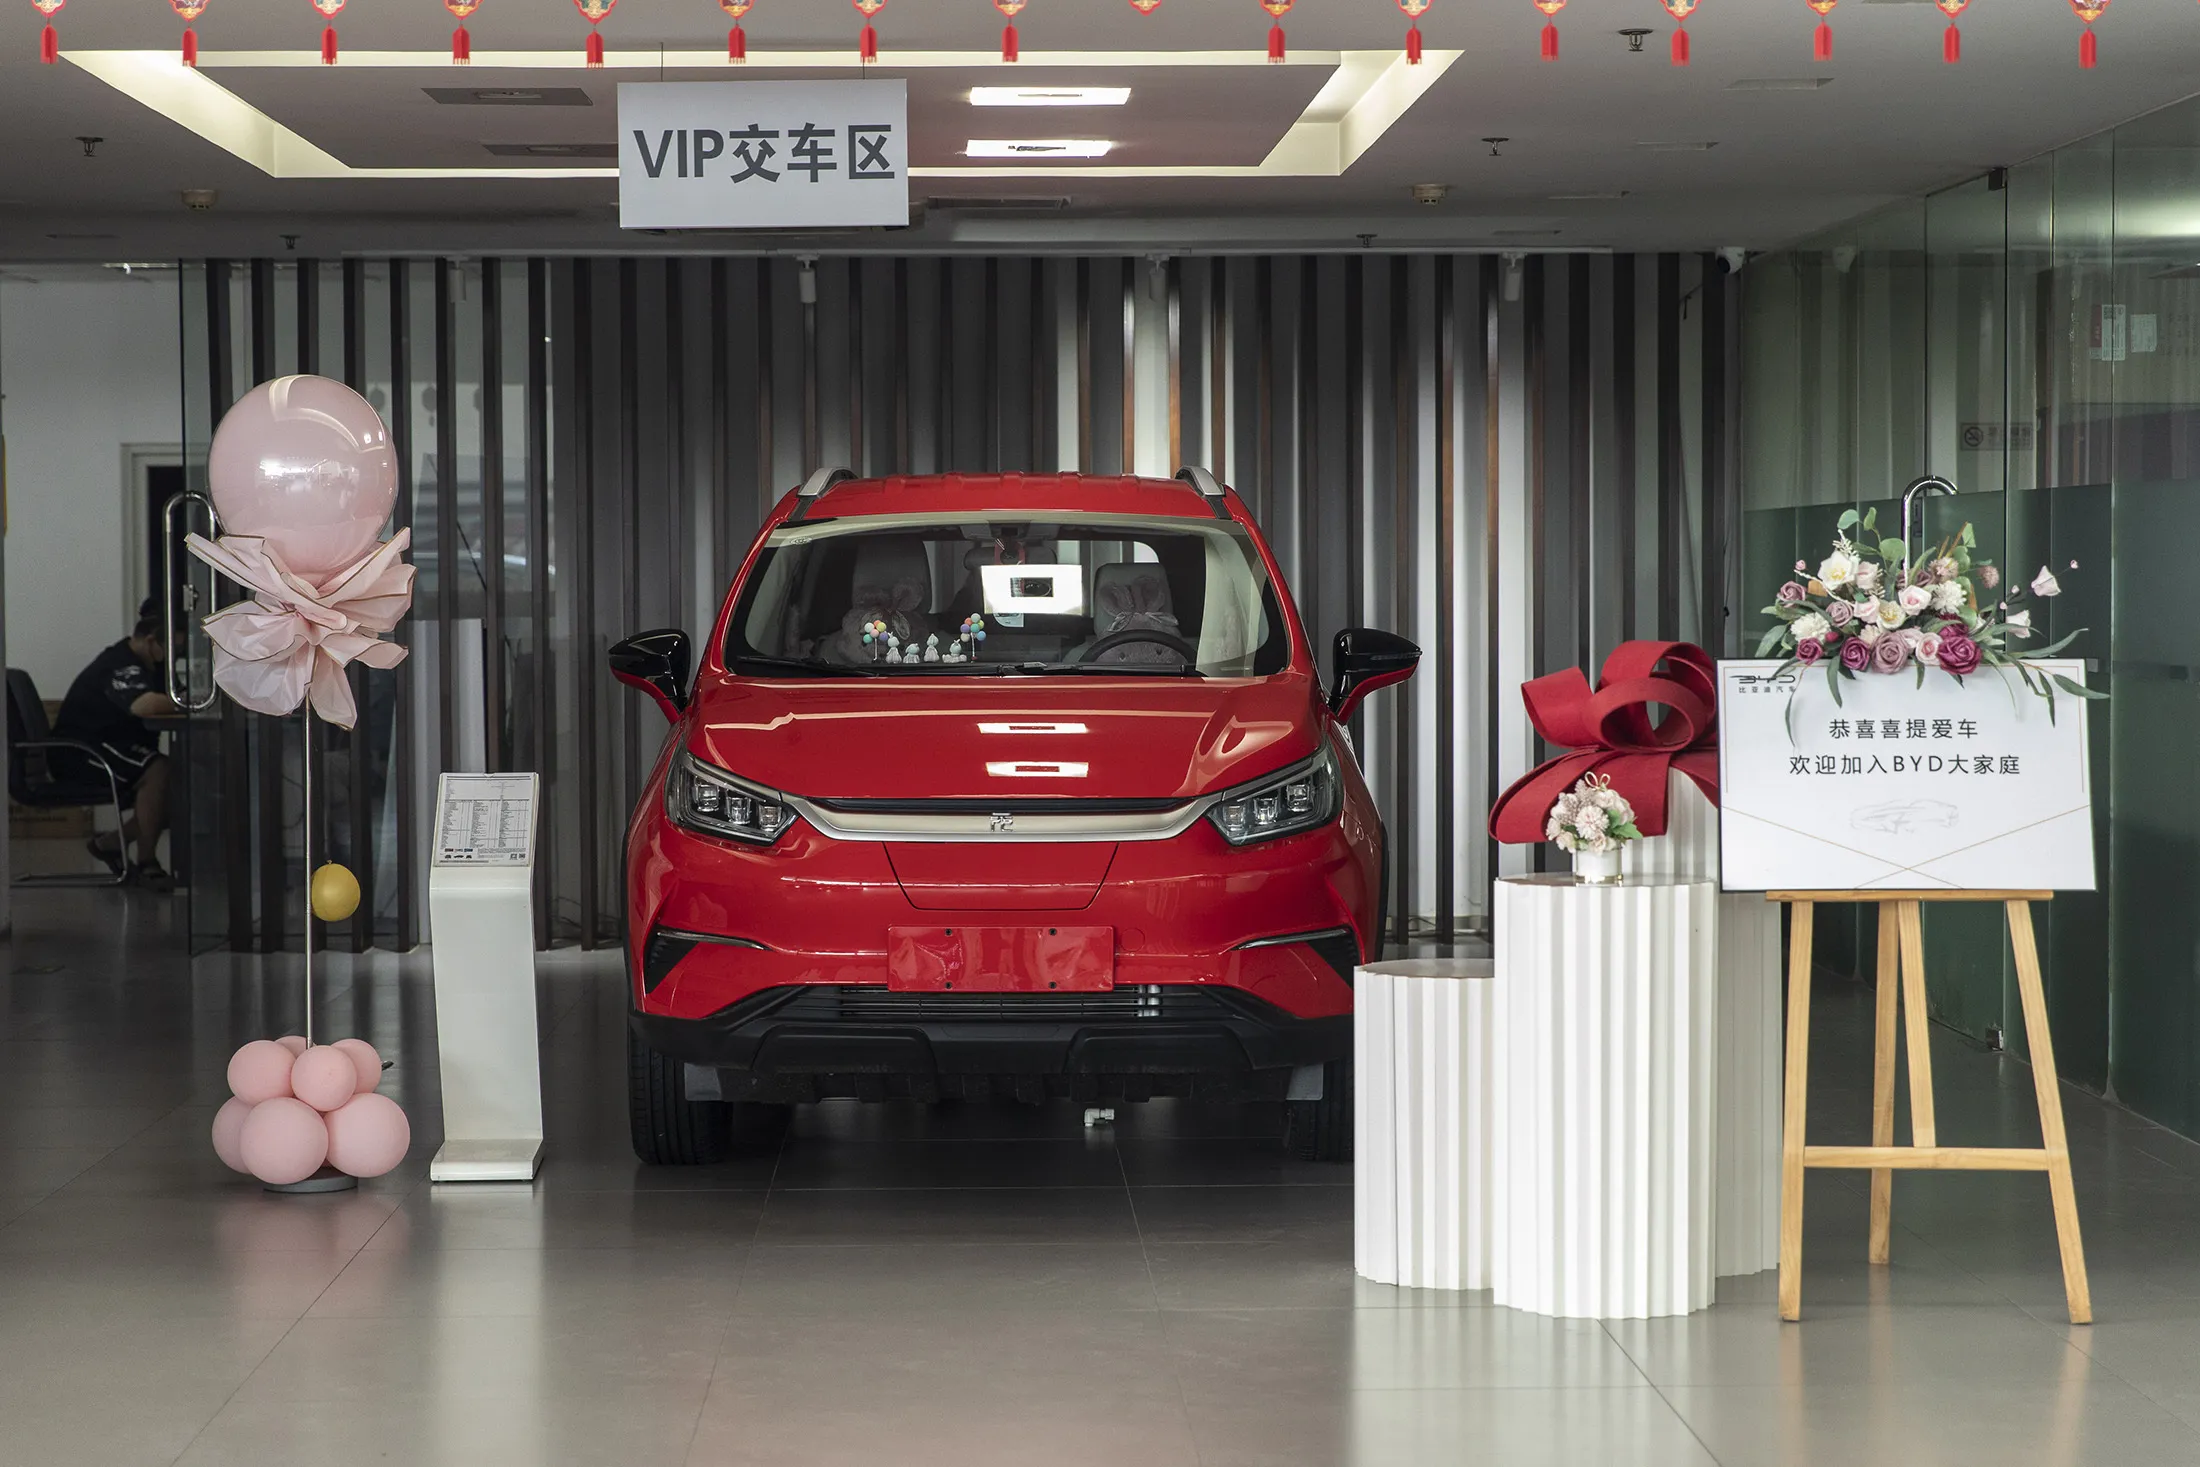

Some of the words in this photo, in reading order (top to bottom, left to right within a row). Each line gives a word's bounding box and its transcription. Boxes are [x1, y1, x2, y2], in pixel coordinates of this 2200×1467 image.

[633, 122, 895, 183] VIP交车区
[1829, 718, 1978, 739] 恭喜喜提爱车
[1789, 754, 2020, 775] 欢迎加入BYD大家庭
